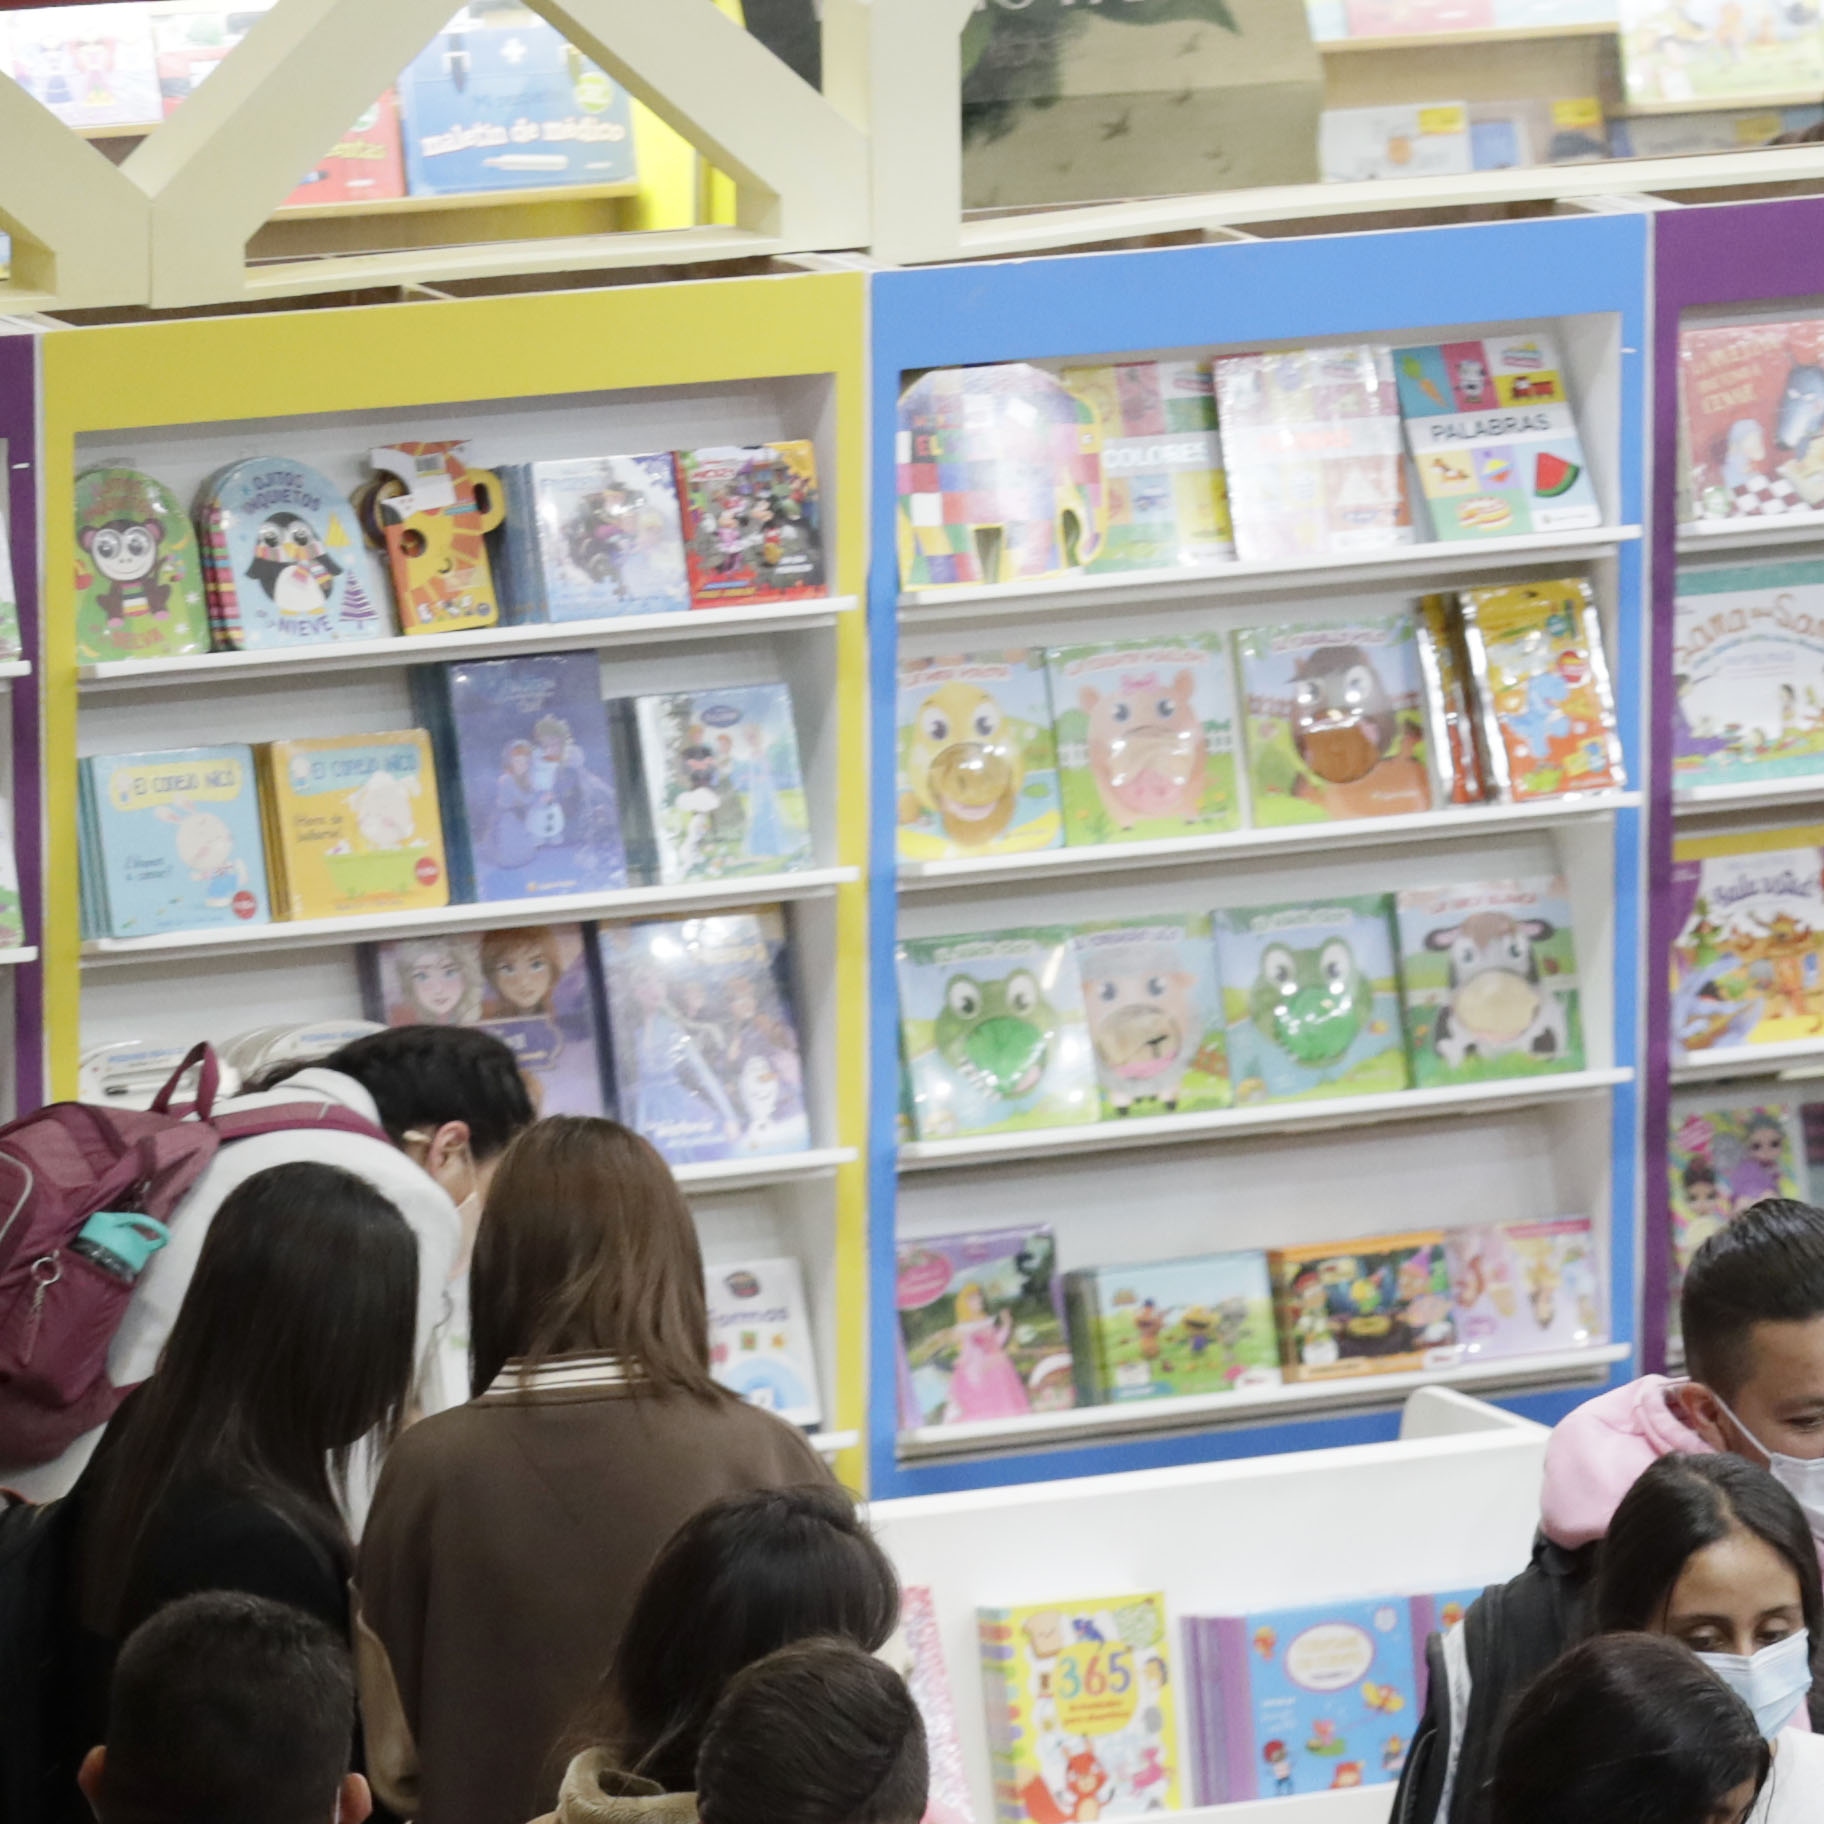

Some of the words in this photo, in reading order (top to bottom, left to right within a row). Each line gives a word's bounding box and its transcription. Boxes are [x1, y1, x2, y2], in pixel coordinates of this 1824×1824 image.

[1430, 411, 1552, 442] PALABRAS
[277, 613, 334, 638] NIEVE
[1059, 1651, 1131, 1699] 365
